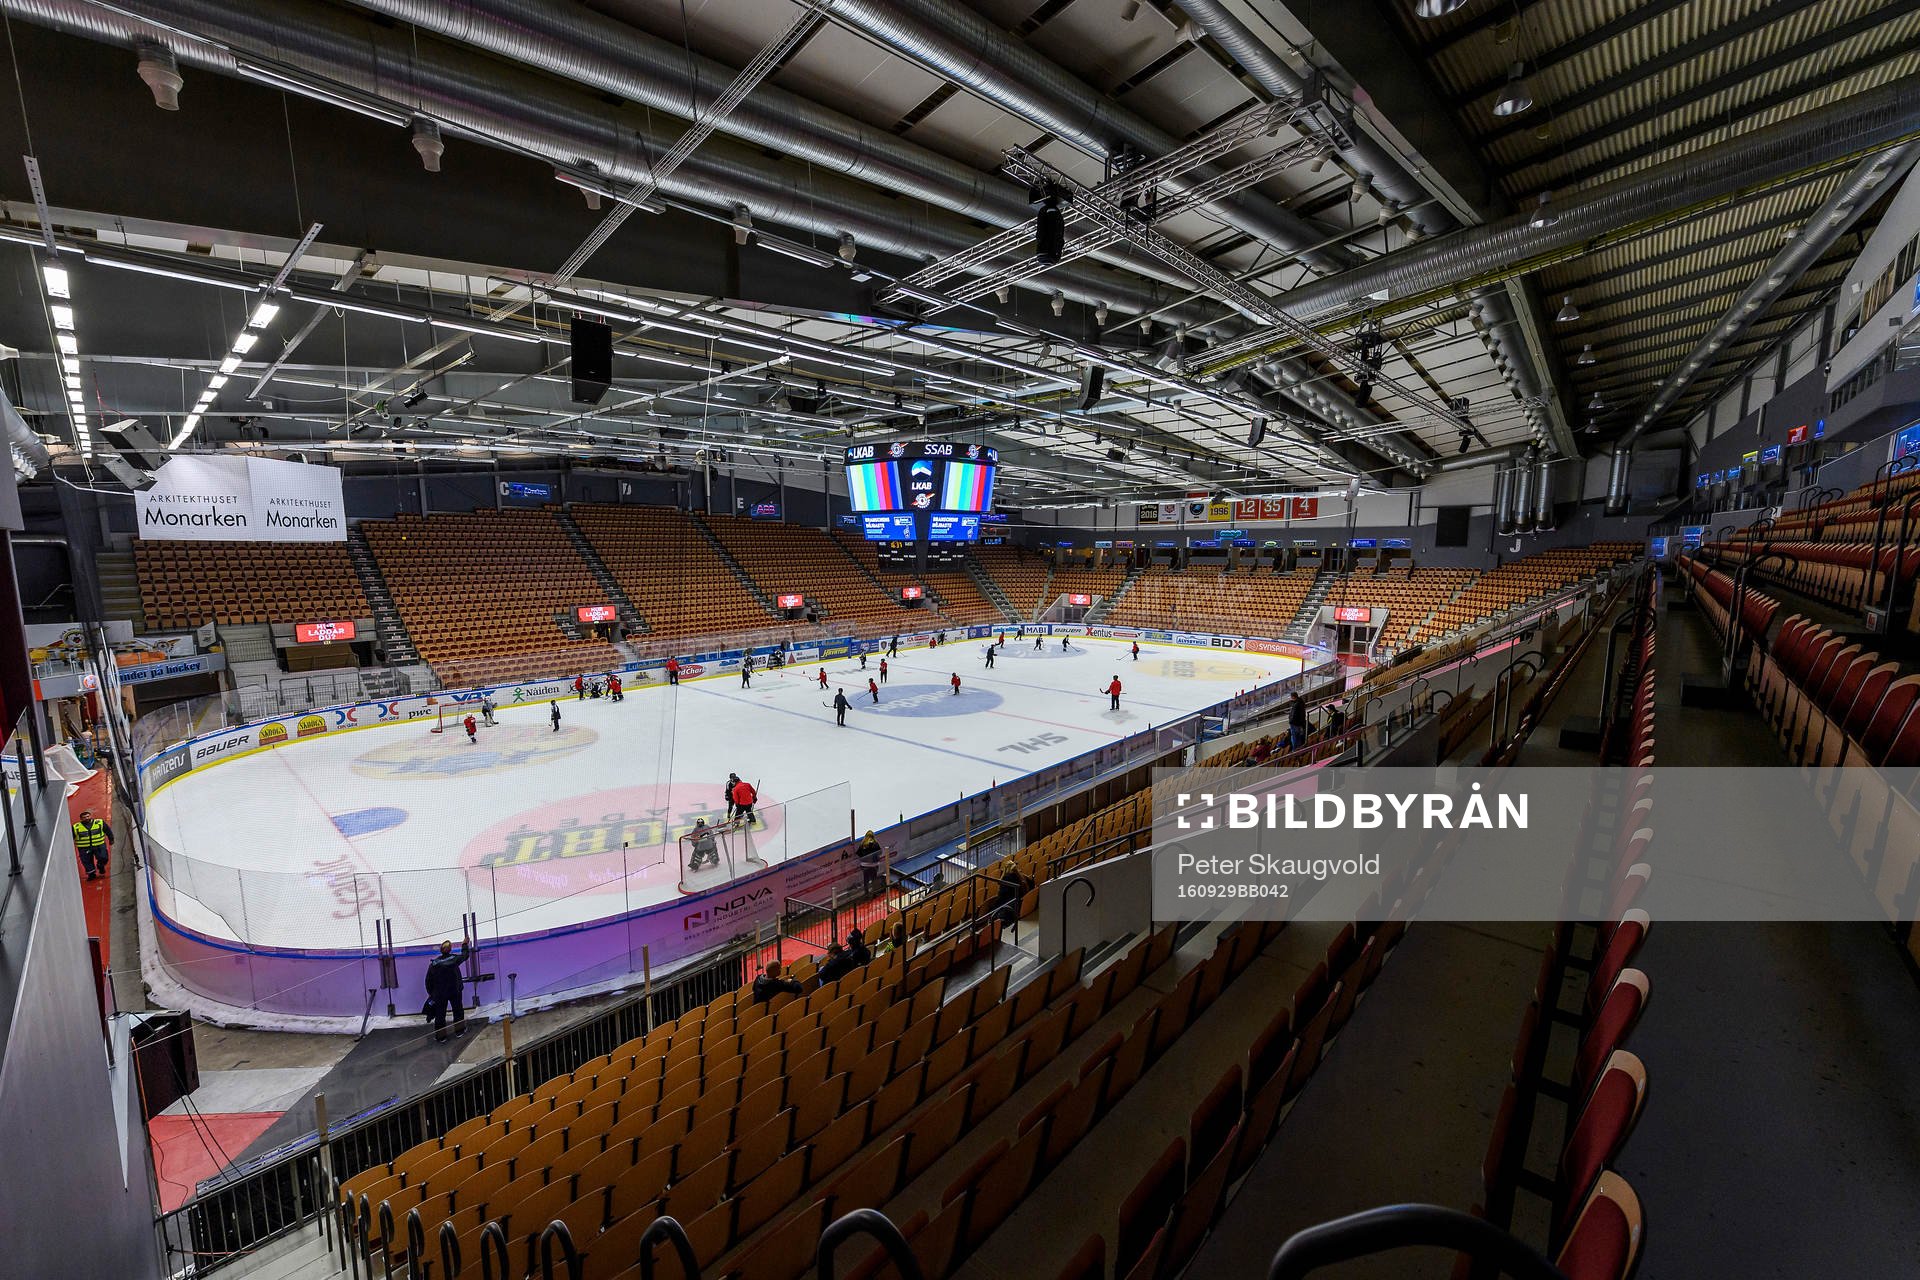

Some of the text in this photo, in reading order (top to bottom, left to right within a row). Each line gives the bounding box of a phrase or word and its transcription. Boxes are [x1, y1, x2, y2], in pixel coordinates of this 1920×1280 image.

[853, 445, 874, 459] LKAB
[924, 444, 953, 455] SSAB
[500, 482, 510, 495] C
[911, 482, 932, 490] LKAB
[149, 494, 238, 504] ARKITEKTHUSET
[269, 497, 331, 508] ARKITEKTHUSET
[737, 498, 744, 508] E
[1300, 498, 1309, 511] 4
[1210, 507, 1229, 516] 1996
[1241, 500, 1255, 513] 12
[1264, 500, 1280, 512] 35
[145, 506, 247, 527] Monarken
[266, 509, 338, 529] Monarken
[1141, 510, 1158, 519] 2016
[308, 628, 345, 637] LADDAR
[1086, 627, 1112, 638] Xentus
[1211, 638, 1243, 649] BDX
[166, 661, 201, 674] hockey
[408, 708, 432, 720] pwc
[196, 735, 250, 759] BAUER
[714, 887, 773, 916] NOVA
